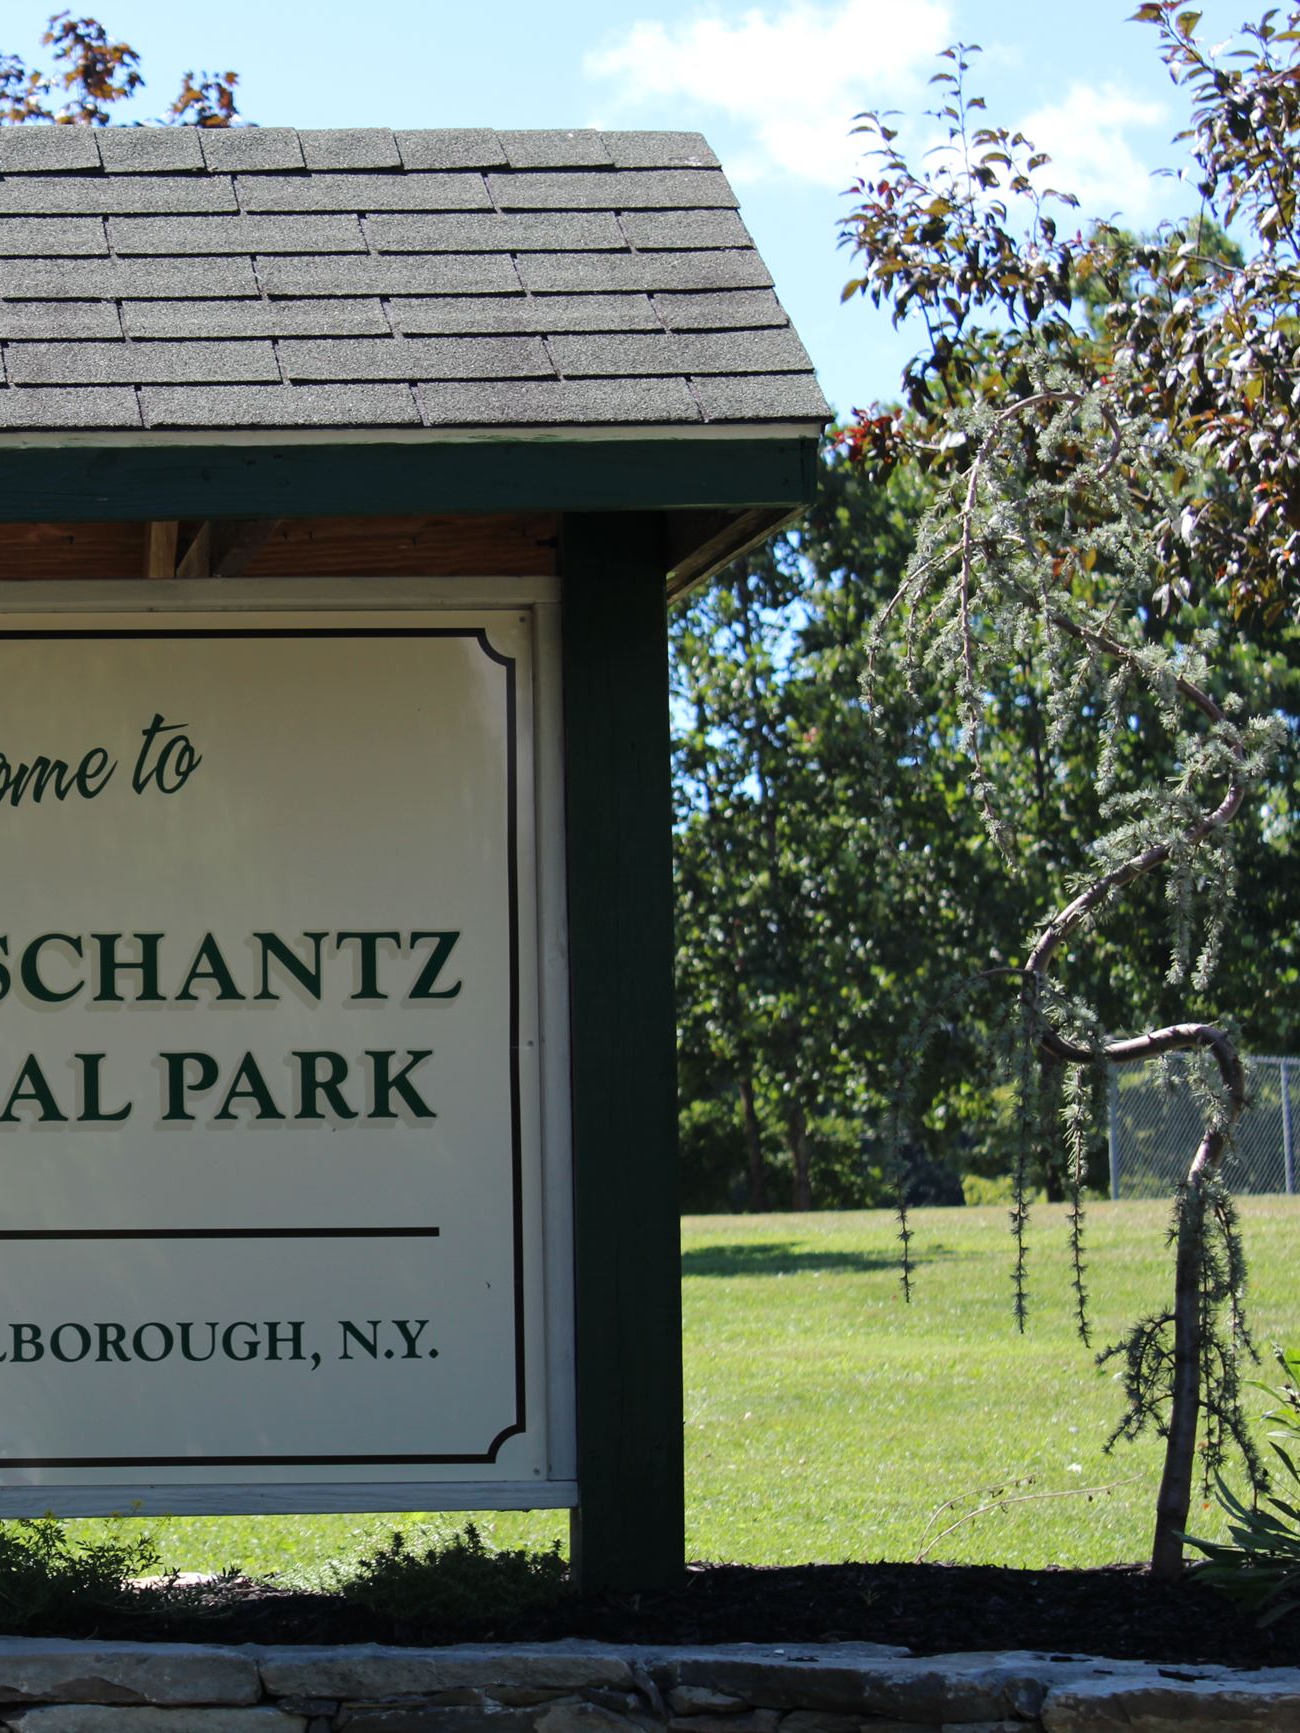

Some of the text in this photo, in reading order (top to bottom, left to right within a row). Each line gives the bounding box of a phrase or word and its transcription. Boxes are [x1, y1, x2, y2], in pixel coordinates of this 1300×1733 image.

[131, 712, 203, 795] to
[159, 1049, 437, 1121] PARK
[338, 1319, 439, 1360] N.Y.
